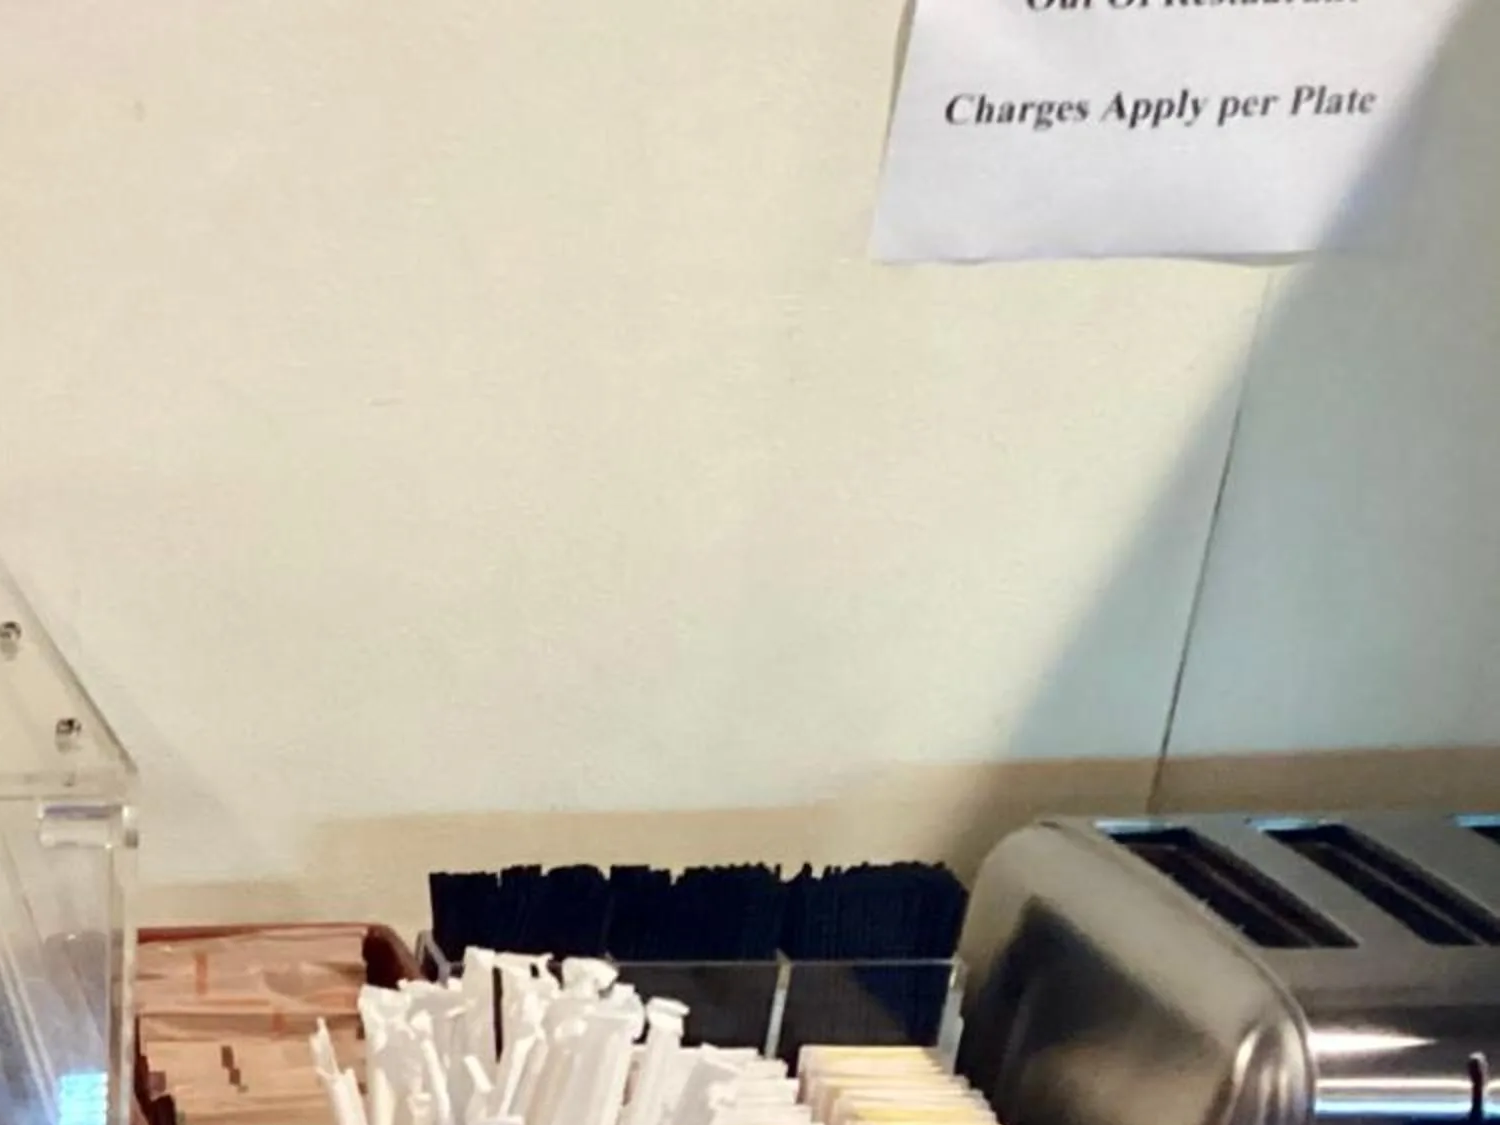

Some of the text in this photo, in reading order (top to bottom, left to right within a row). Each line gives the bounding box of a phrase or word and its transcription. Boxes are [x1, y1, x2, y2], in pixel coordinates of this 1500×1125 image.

[944, 84, 1378, 130] Charges Apply per Plate
